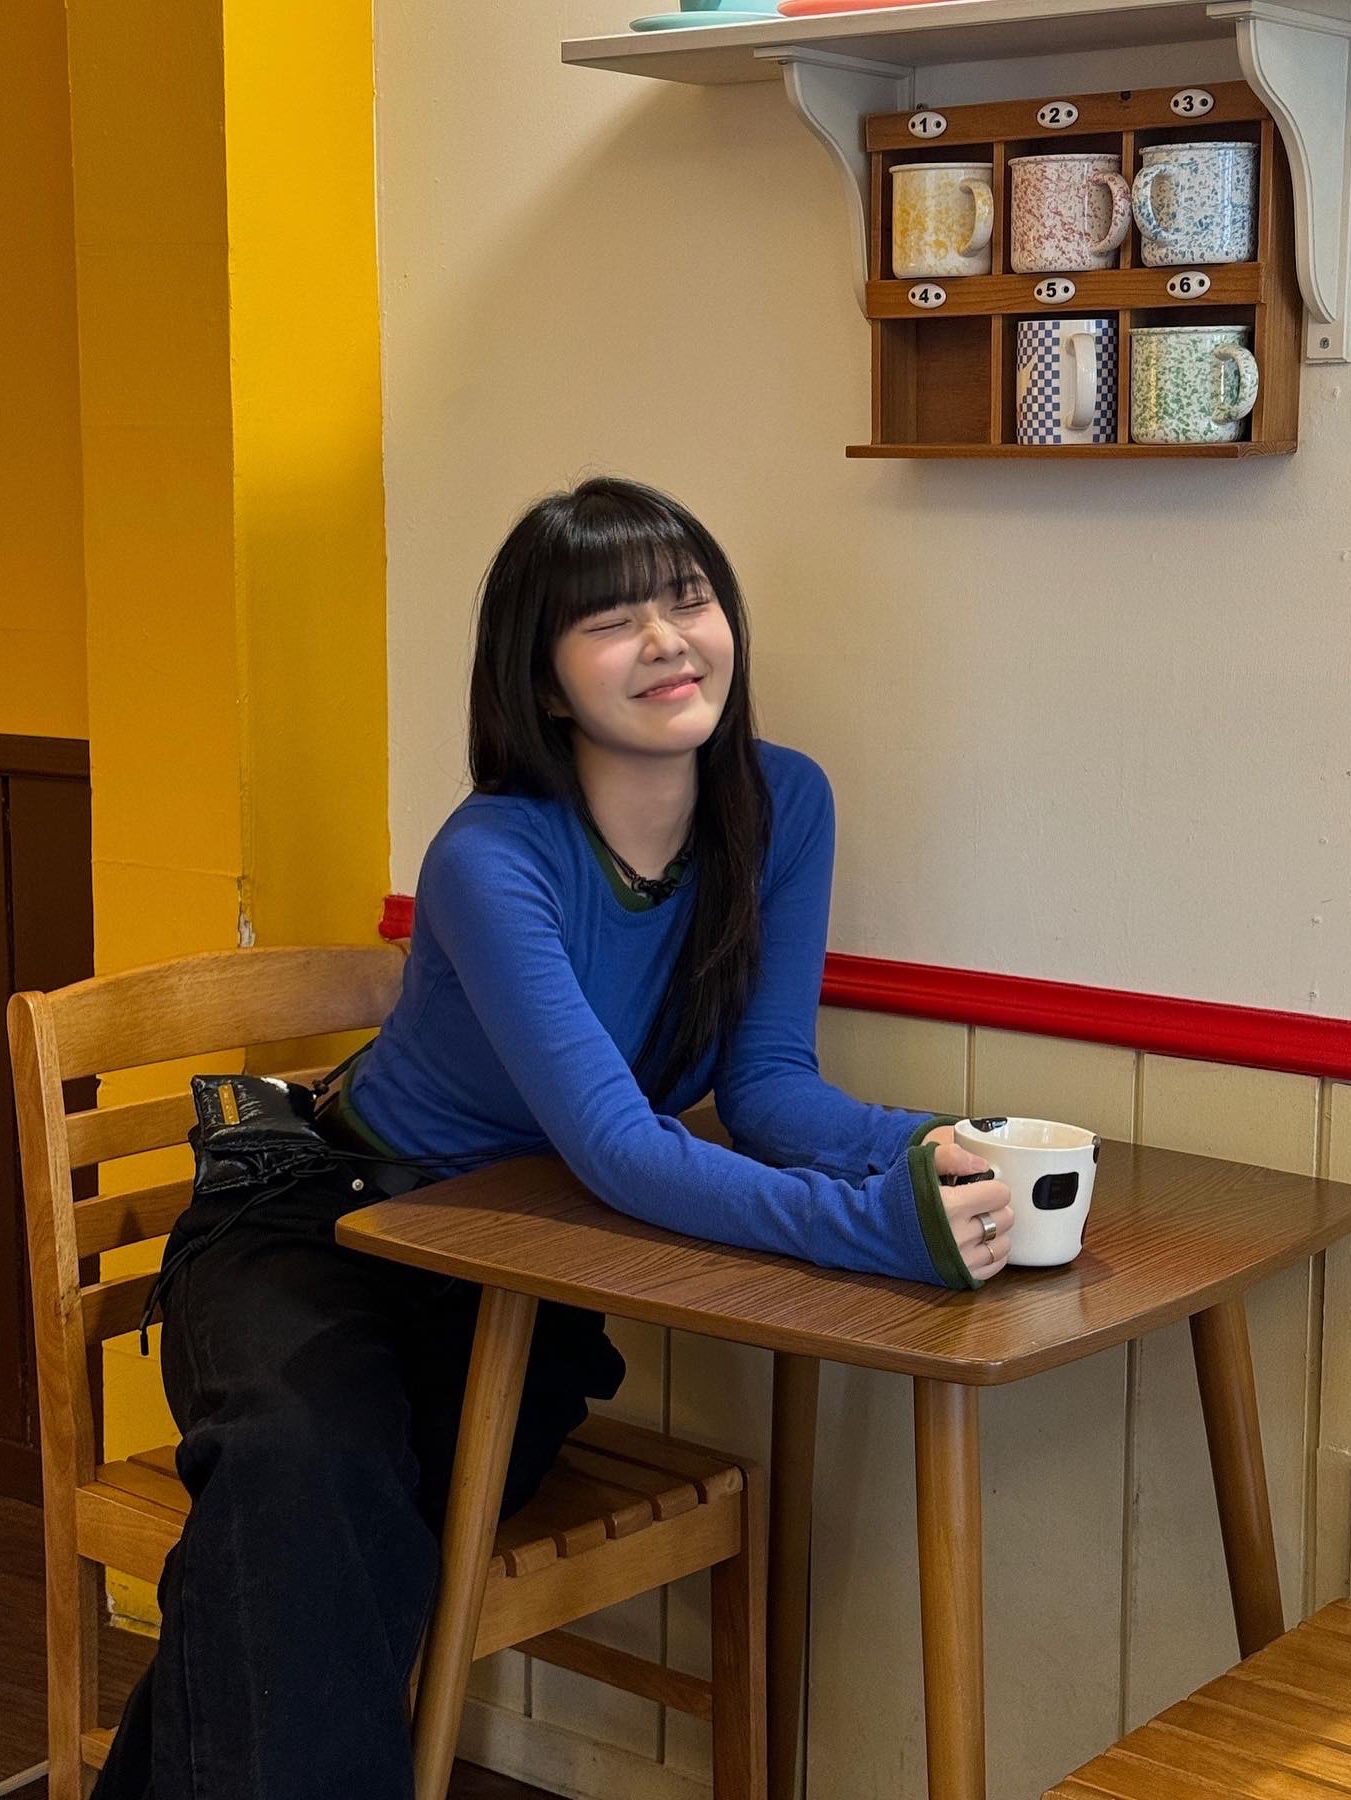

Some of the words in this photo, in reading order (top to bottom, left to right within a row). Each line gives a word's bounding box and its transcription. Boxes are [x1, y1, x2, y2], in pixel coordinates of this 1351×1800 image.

[1182, 95, 1194, 112] 3
[1049, 107, 1061, 124] 2
[919, 117, 928, 133] 1
[1046, 282, 1057, 298] 5
[1180, 277, 1191, 293] 6
[919, 288, 930, 304] 4
